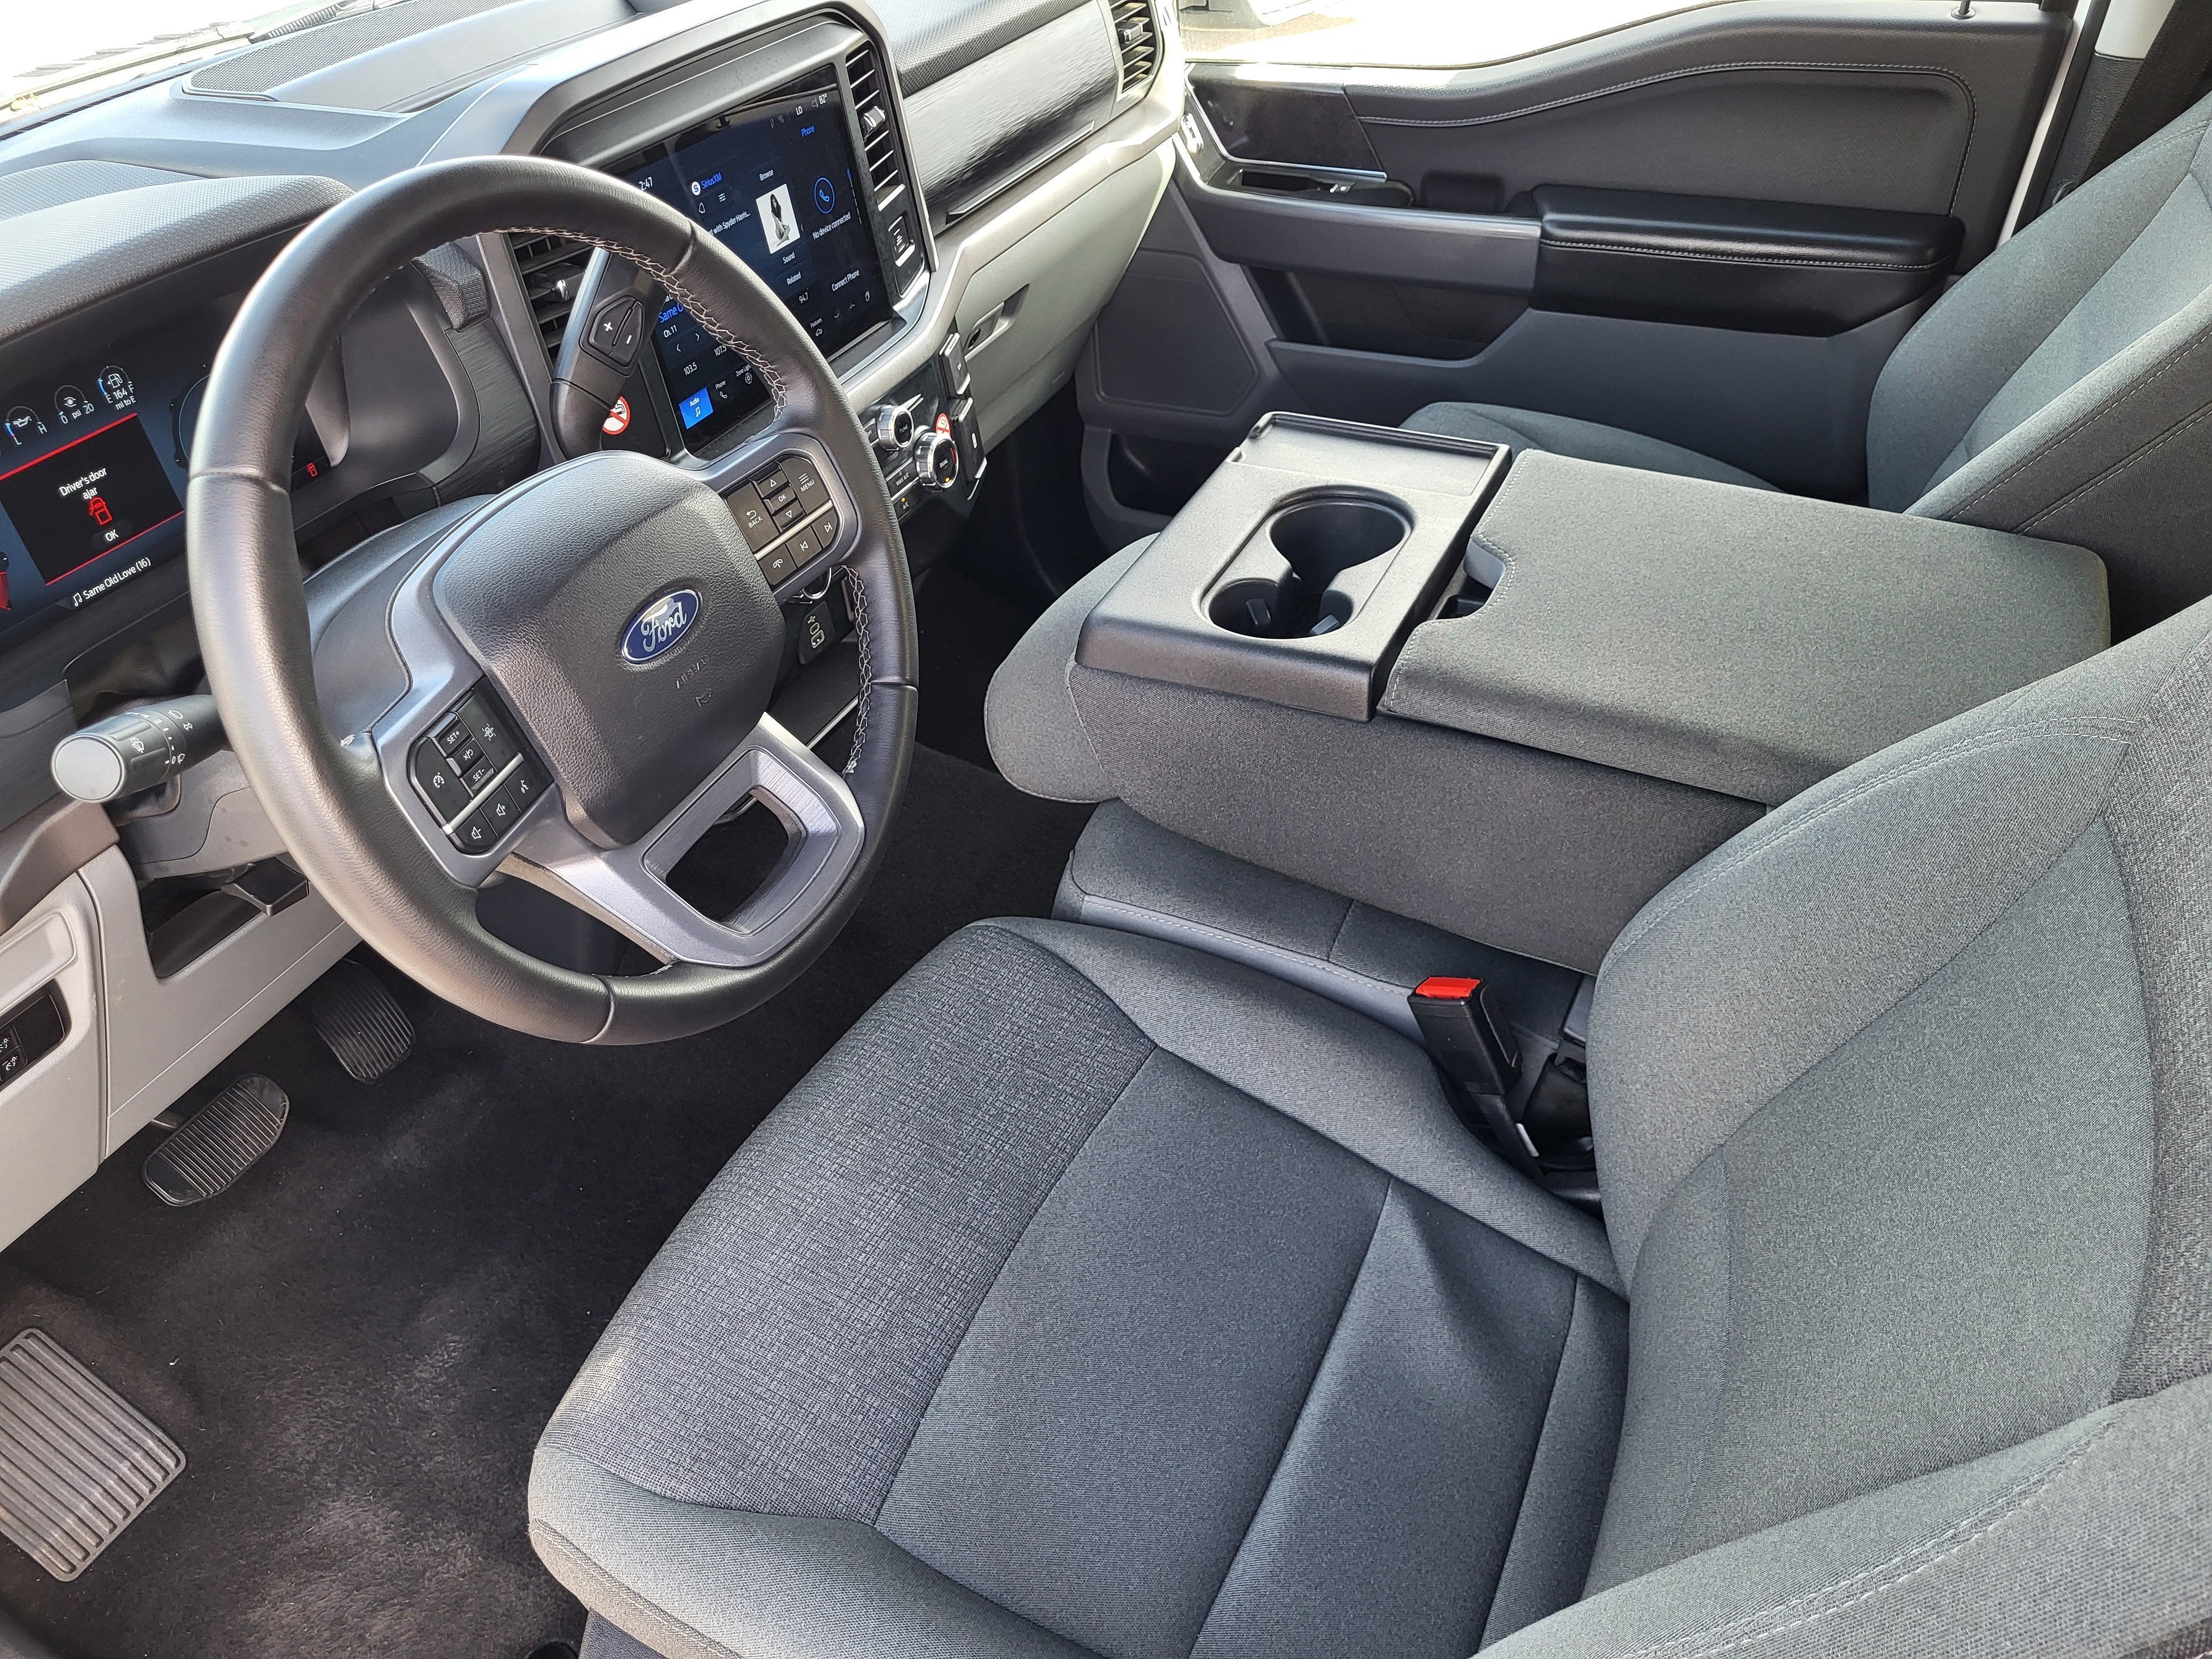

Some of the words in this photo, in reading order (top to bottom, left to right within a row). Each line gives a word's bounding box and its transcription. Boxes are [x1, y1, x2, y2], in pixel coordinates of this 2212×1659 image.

[795, 106, 803, 115] LO
[801, 125, 815, 138] Phone
[701, 172, 722, 189] SiriusXM
[759, 169, 774, 181] Browse
[639, 176, 653, 191] 2:47
[713, 223, 723, 234] with
[722, 217, 737, 229] Spyder
[812, 231, 820, 240] No
[819, 225, 832, 236] device
[831, 212, 851, 229] connected
[782, 251, 795, 264] Sound
[786, 271, 801, 285] Related
[832, 276, 848, 291] Connect
[847, 270, 860, 282] Phone
[799, 292, 808, 304] 94.7
[659, 306, 678, 323] Same
[670, 325, 678, 333] 11
[714, 344, 727, 357] 107.5
[683, 361, 697, 376] 103.5
[715, 380, 726, 391] Phone
[106, 394, 114, 404] E
[113, 388, 128, 400] 164
[128, 384, 134, 394] F
[690, 397, 700, 407] Audio
[60, 415, 68, 424] 0
[82, 403, 95, 415] 20
[37, 423, 48, 435] H
[14, 436, 22, 446] L
[59, 477, 90, 496] Driver's
[88, 468, 107, 482] door
[800, 478, 816, 493] MENU
[82, 487, 98, 499] ajar
[778, 493, 787, 502] OK
[747, 515, 763, 529] BACK
[105, 529, 119, 541] OK
[83, 583, 106, 599] Same
[104, 573, 119, 587] Old
[117, 566, 137, 581] Love
[135, 557, 151, 571] (16)
[640, 601, 687, 653] Ford
